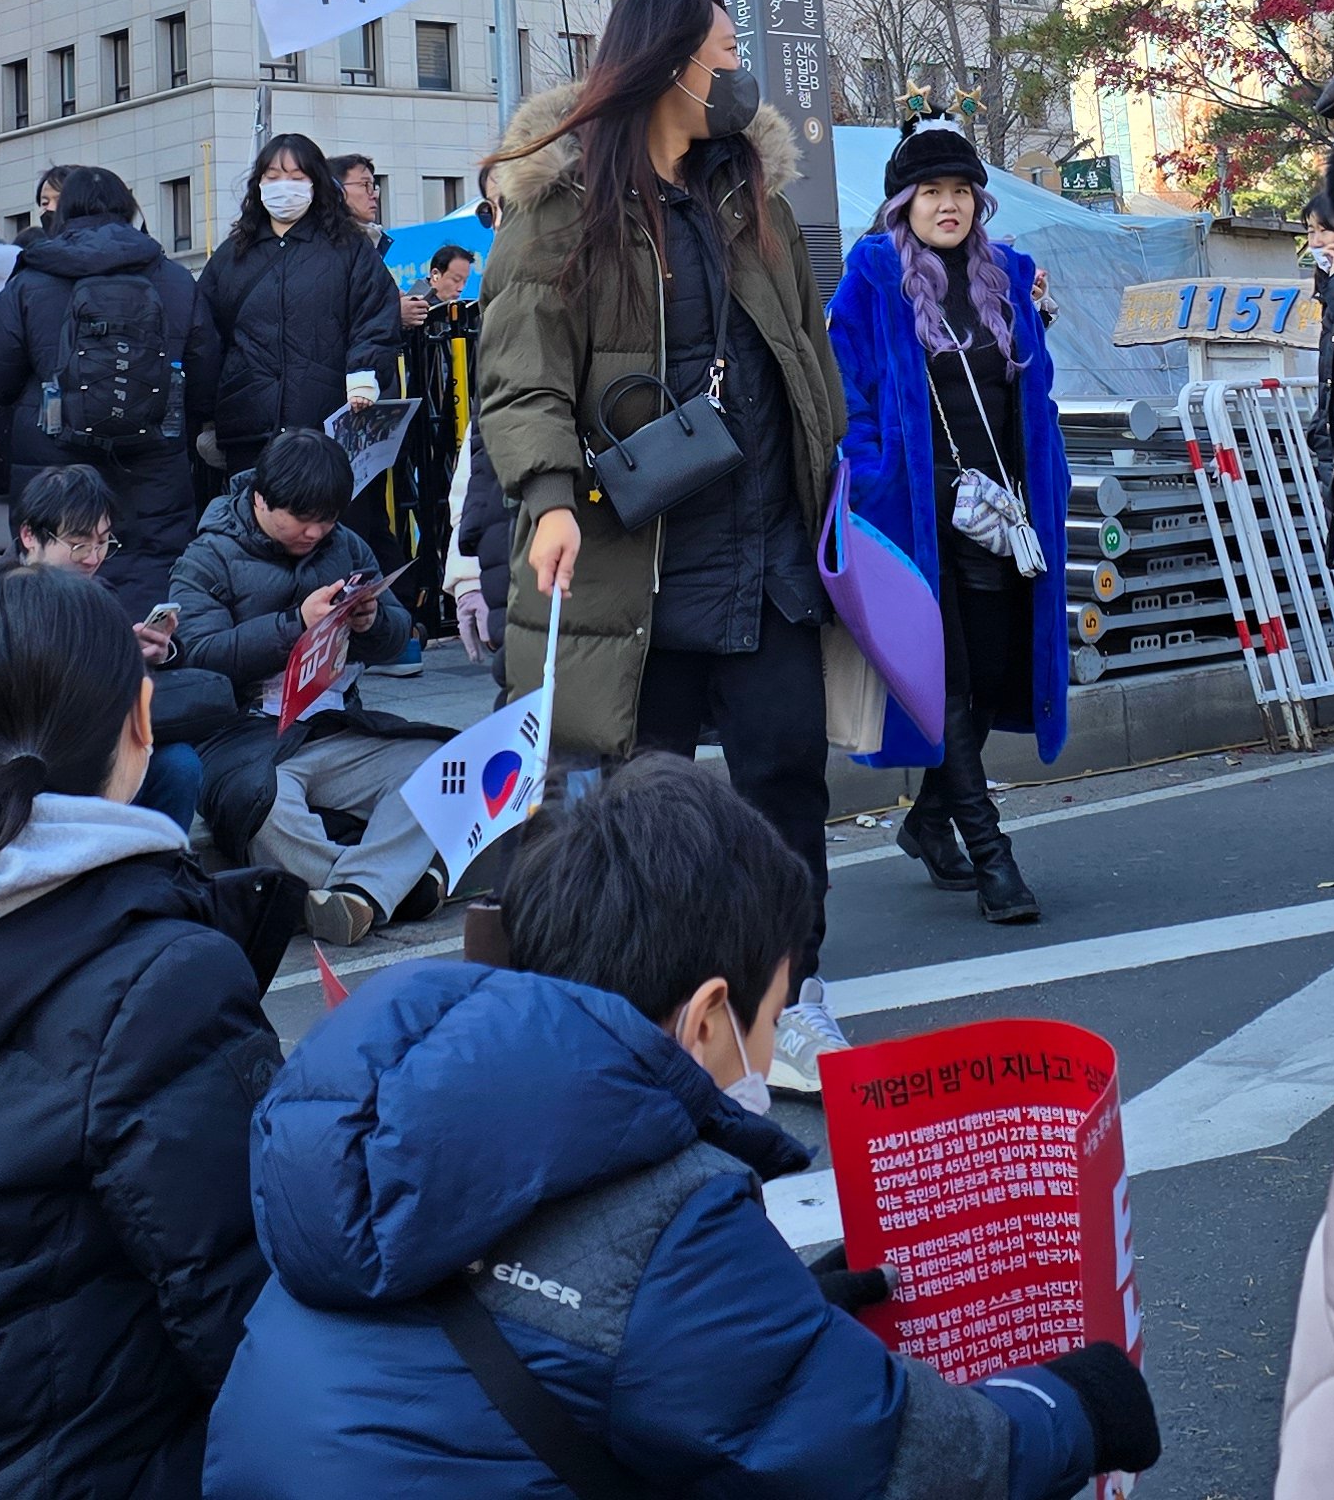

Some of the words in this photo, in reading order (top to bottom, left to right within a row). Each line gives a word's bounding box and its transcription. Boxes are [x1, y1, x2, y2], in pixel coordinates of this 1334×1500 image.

[782, 43, 792, 66] KDB
[795, 41, 812, 109] 산업은행
[807, 43, 820, 90] KDB
[783, 68, 794, 96] Bank
[808, 121, 819, 139] 9
[1177, 284, 1300, 333] 1157
[1000, 1052, 1075, 1084] 지나고
[868, 1131, 910, 1154] 21세기
[911, 1118, 959, 1144] 대명천지
[959, 1107, 1021, 1131] 대한민국에
[1022, 1106, 1065, 1123] ‘계엄의
[871, 1151, 915, 1173] 2024년
[918, 1144, 945, 1163] 12월
[945, 1137, 965, 1156] 3일
[965, 1135, 978, 1150] 밤
[980, 1128, 1008, 1147] 10시
[1010, 1126, 1038, 1141] 27분
[874, 1170, 919, 1192] 1979년
[920, 1164, 944, 1181] 이후
[945, 1155, 971, 1174] 45년
[972, 1149, 998, 1168] 만의
[999, 1144, 1037, 1165] 일이자
[876, 1193, 903, 1211] 이는
[904, 1183, 941, 1205] 국민의
[942, 1171, 988, 1195] 기본권과
[990, 1162, 1028, 1181] 주권을
[981, 1184, 1006, 1204] 내란
[1007, 1179, 1045, 1198] 행위를
[1048, 1180, 1073, 1196] 벌인
[884, 1249, 912, 1265] 지금
[912, 1229, 971, 1259] 대한민국에
[972, 1227, 984, 1242] 단
[985, 1216, 1022, 1237] 하나의
[897, 1267, 914, 1283] 금
[915, 1247, 974, 1279] 대한민국에
[974, 1245, 987, 1260] 단
[988, 1234, 1025, 1256] 하나의
[891, 1288, 917, 1303] 지금
[918, 1268, 976, 1298] 대한민국에
[977, 1264, 990, 1280] 단
[990, 1253, 1027, 1274] 하나의
[938, 1308, 962, 1328] 달한
[963, 1300, 987, 1318] 악은
[988, 1288, 1024, 1311] 스스로
[1024, 1280, 1082, 1300] 무너진다’
[898, 1339, 924, 1356] 피와
[926, 1328, 962, 1350] 눈물로
[963, 1317, 998, 1339] 이뤄낸
[998, 1311, 1011, 1327] 이
[1012, 1304, 1036, 1323] 땅의
[940, 1348, 965, 1366] 밤이
[966, 1342, 988, 1359] 가고
[989, 1332, 1013, 1351] 아침
[1015, 1323, 1038, 1341] 해가
[940, 1367, 967, 1385] 로를
[1008, 1348, 1031, 1365] 우리
[1033, 1336, 1070, 1356] 나라를
